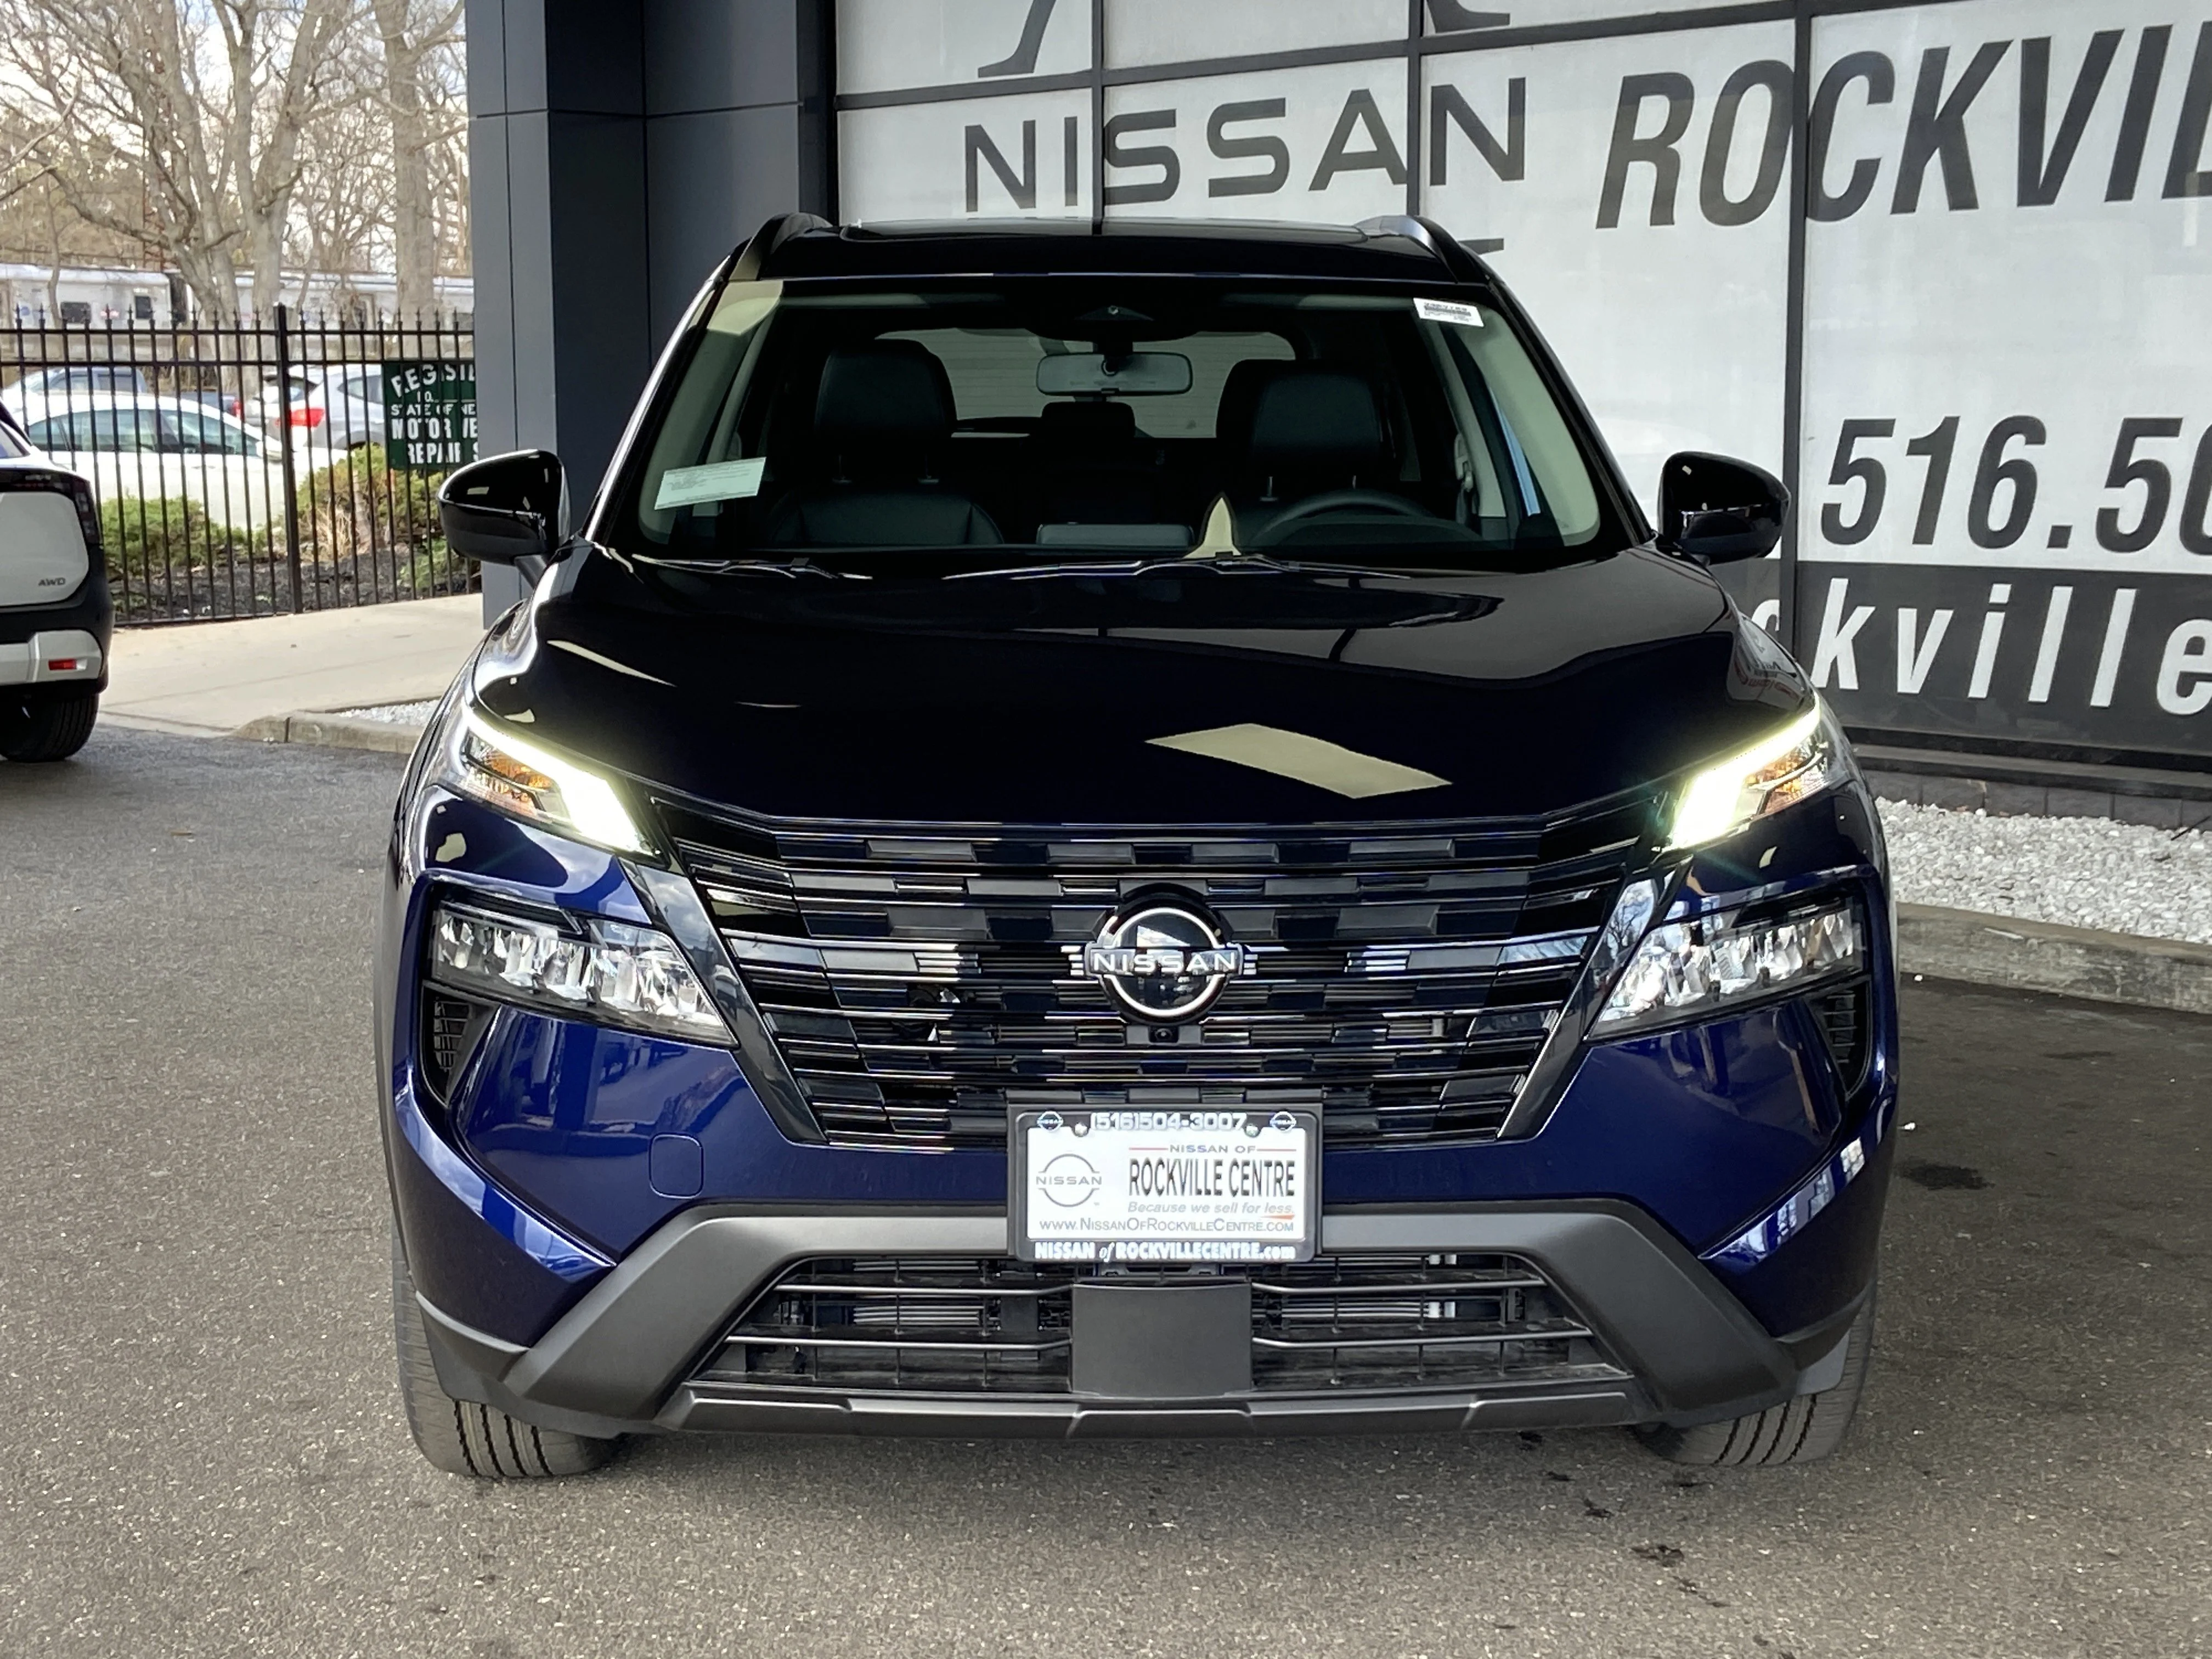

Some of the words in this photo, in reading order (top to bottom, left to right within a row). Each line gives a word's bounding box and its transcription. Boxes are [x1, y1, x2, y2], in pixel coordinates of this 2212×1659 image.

[964, 77, 1526, 213] NISSAN
[38, 578, 65, 586] AWD
[1093, 952, 1235, 973] NISSAN
[1170, 1144, 1228, 1153] NISSAN
[1036, 1176, 1102, 1185] NISSAN
[1129, 1157, 1223, 1197] ROCKVILLE
[1228, 1158, 1295, 1198] CENTRE
[1128, 1201, 1186, 1213] Because
[1191, 1205, 1210, 1214] we
[1214, 1202, 1238, 1214] sell
[1242, 1203, 1261, 1214] for
[1035, 1242, 1096, 1260] NISSAN
[1099, 1242, 1115, 1263] of
